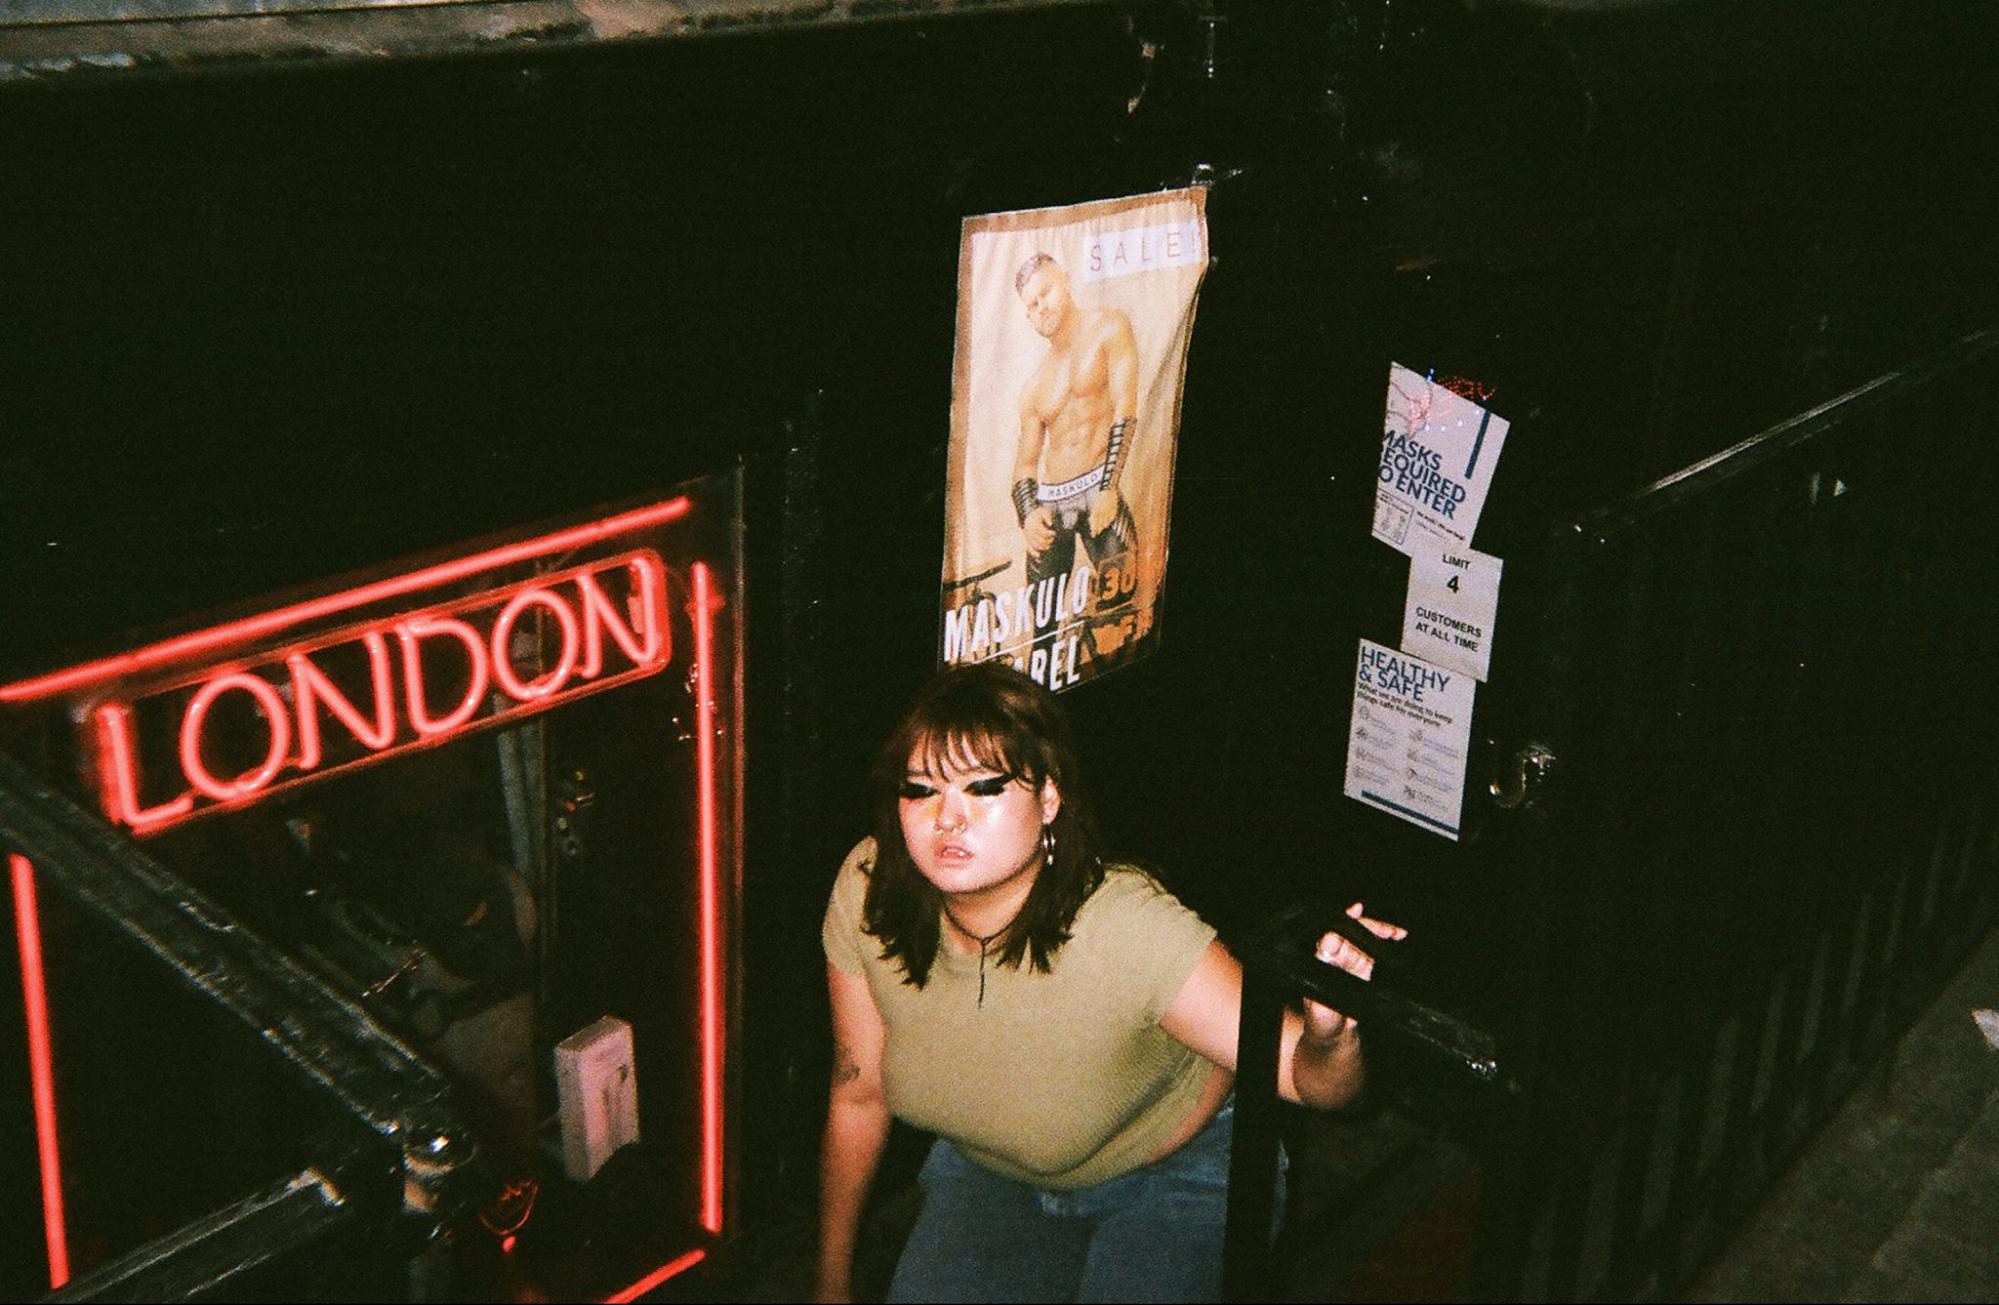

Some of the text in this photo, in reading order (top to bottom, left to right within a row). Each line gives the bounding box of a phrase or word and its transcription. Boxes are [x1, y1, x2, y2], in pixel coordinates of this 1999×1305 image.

[1376, 464, 1394, 483] O
[1395, 471, 1457, 521] ENTER
[1382, 447, 1466, 503] EQUIRED
[1441, 553, 1471, 571] LIMIT
[1446, 575, 1460, 594] 4
[943, 566, 1090, 663] MASKULO
[1416, 606, 1482, 638] CUSTOMERS
[1415, 622, 1479, 652] AT ALL TIME
[1359, 664, 1424, 702] & SAFE
[1360, 646, 1451, 692] HEALTHY
[99, 555, 660, 831] LONDON
